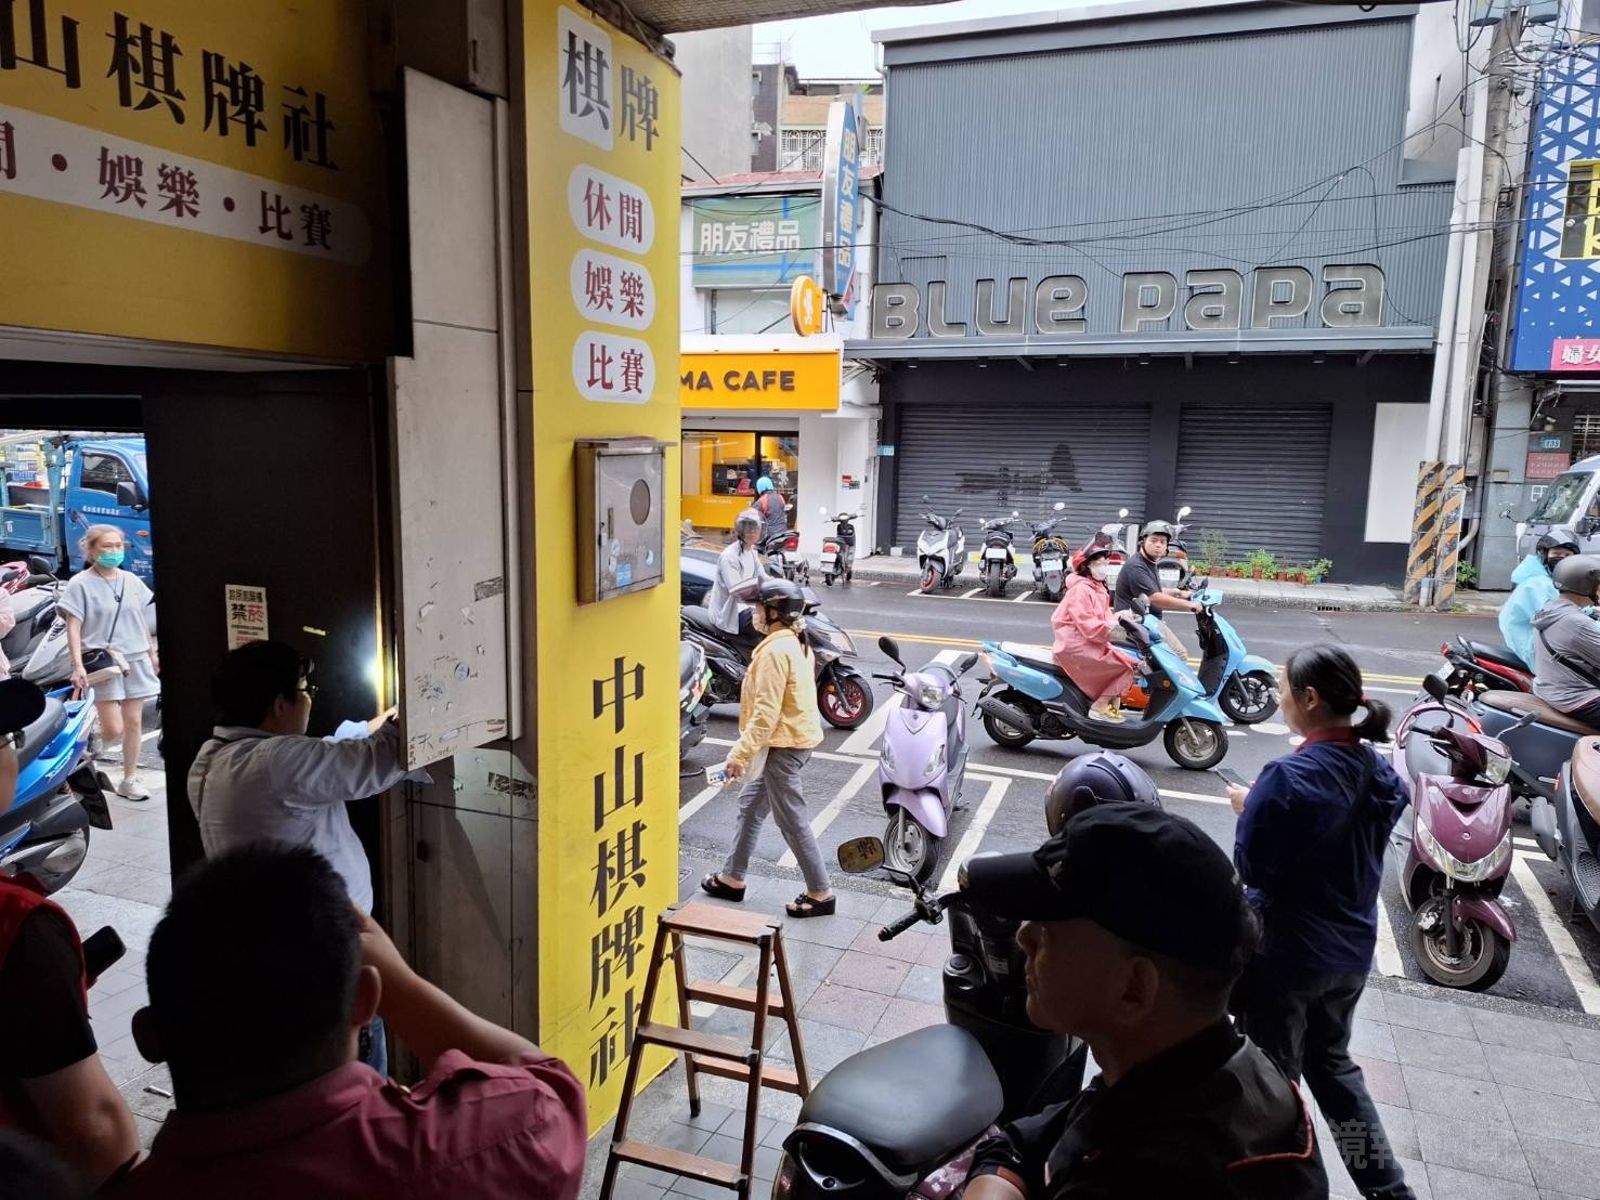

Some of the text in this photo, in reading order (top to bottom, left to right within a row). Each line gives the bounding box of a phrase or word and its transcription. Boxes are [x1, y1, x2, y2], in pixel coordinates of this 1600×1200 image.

[562, 29, 660, 152] 棋牌
[583, 177, 643, 243] 休閒
[700, 219, 801, 257] 朋友禮品
[584, 260, 645, 318] 娛樂
[586, 342, 644, 394] 比賽
[724, 370, 796, 392] CAFE
[589, 656, 648, 1090] 中山棋牌社
